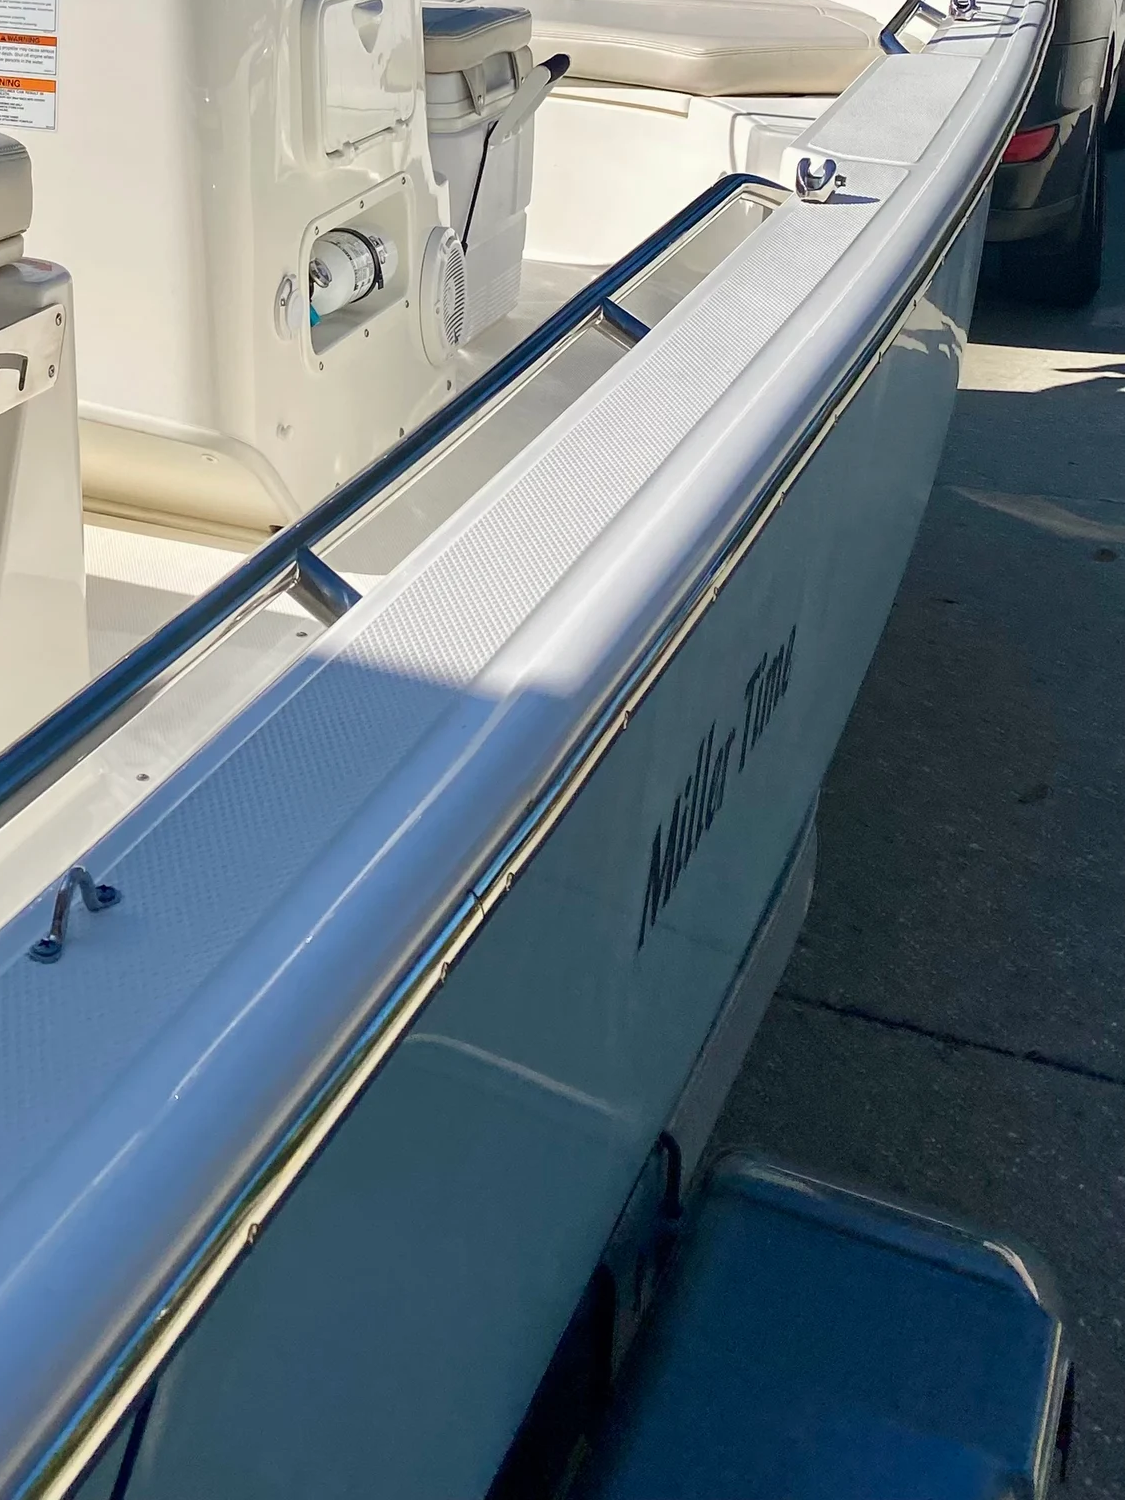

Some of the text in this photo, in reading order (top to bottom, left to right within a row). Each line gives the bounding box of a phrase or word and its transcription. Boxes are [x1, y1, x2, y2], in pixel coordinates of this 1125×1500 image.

[7, 35, 40, 44] WARNING
[637, 623, 797, 953] Miller Time
